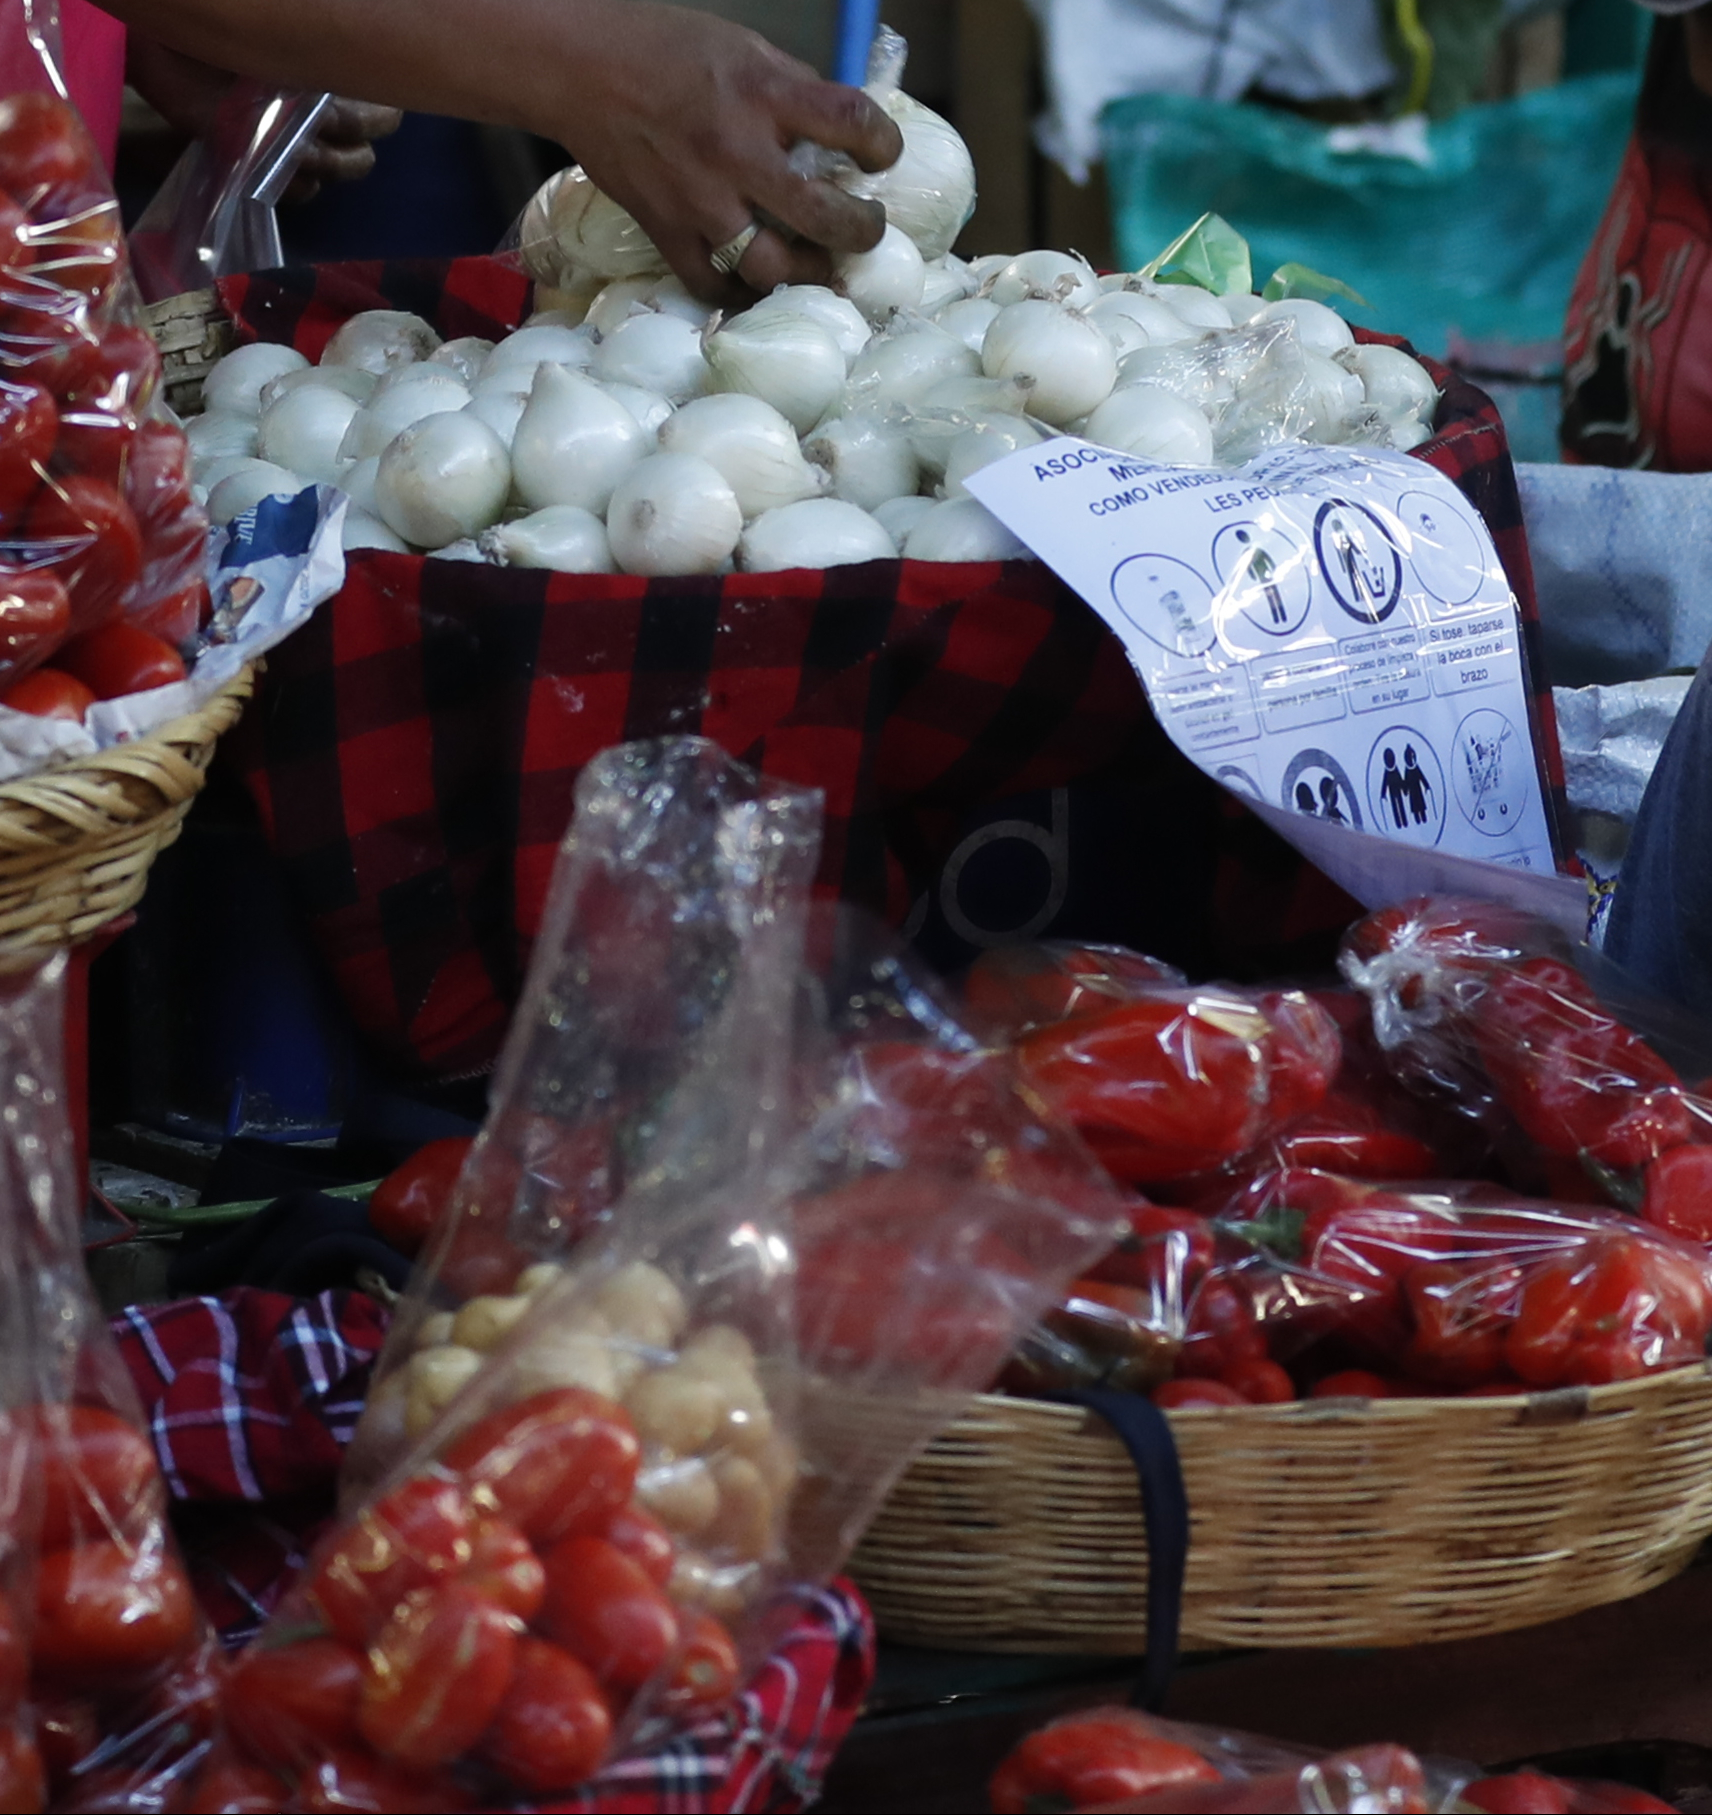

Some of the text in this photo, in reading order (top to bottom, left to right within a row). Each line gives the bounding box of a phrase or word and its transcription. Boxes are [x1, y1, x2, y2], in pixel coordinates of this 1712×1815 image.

[1088, 487, 1149, 517] COMO
[1203, 491, 1243, 513] LES
[1468, 619, 1504, 636] taparse
[1449, 649, 1473, 663] boca
[1474, 646, 1493, 658] con
[1495, 641, 1504, 653] el
[1461, 669, 1488, 684] brazo
[1392, 687, 1409, 702] lugar
